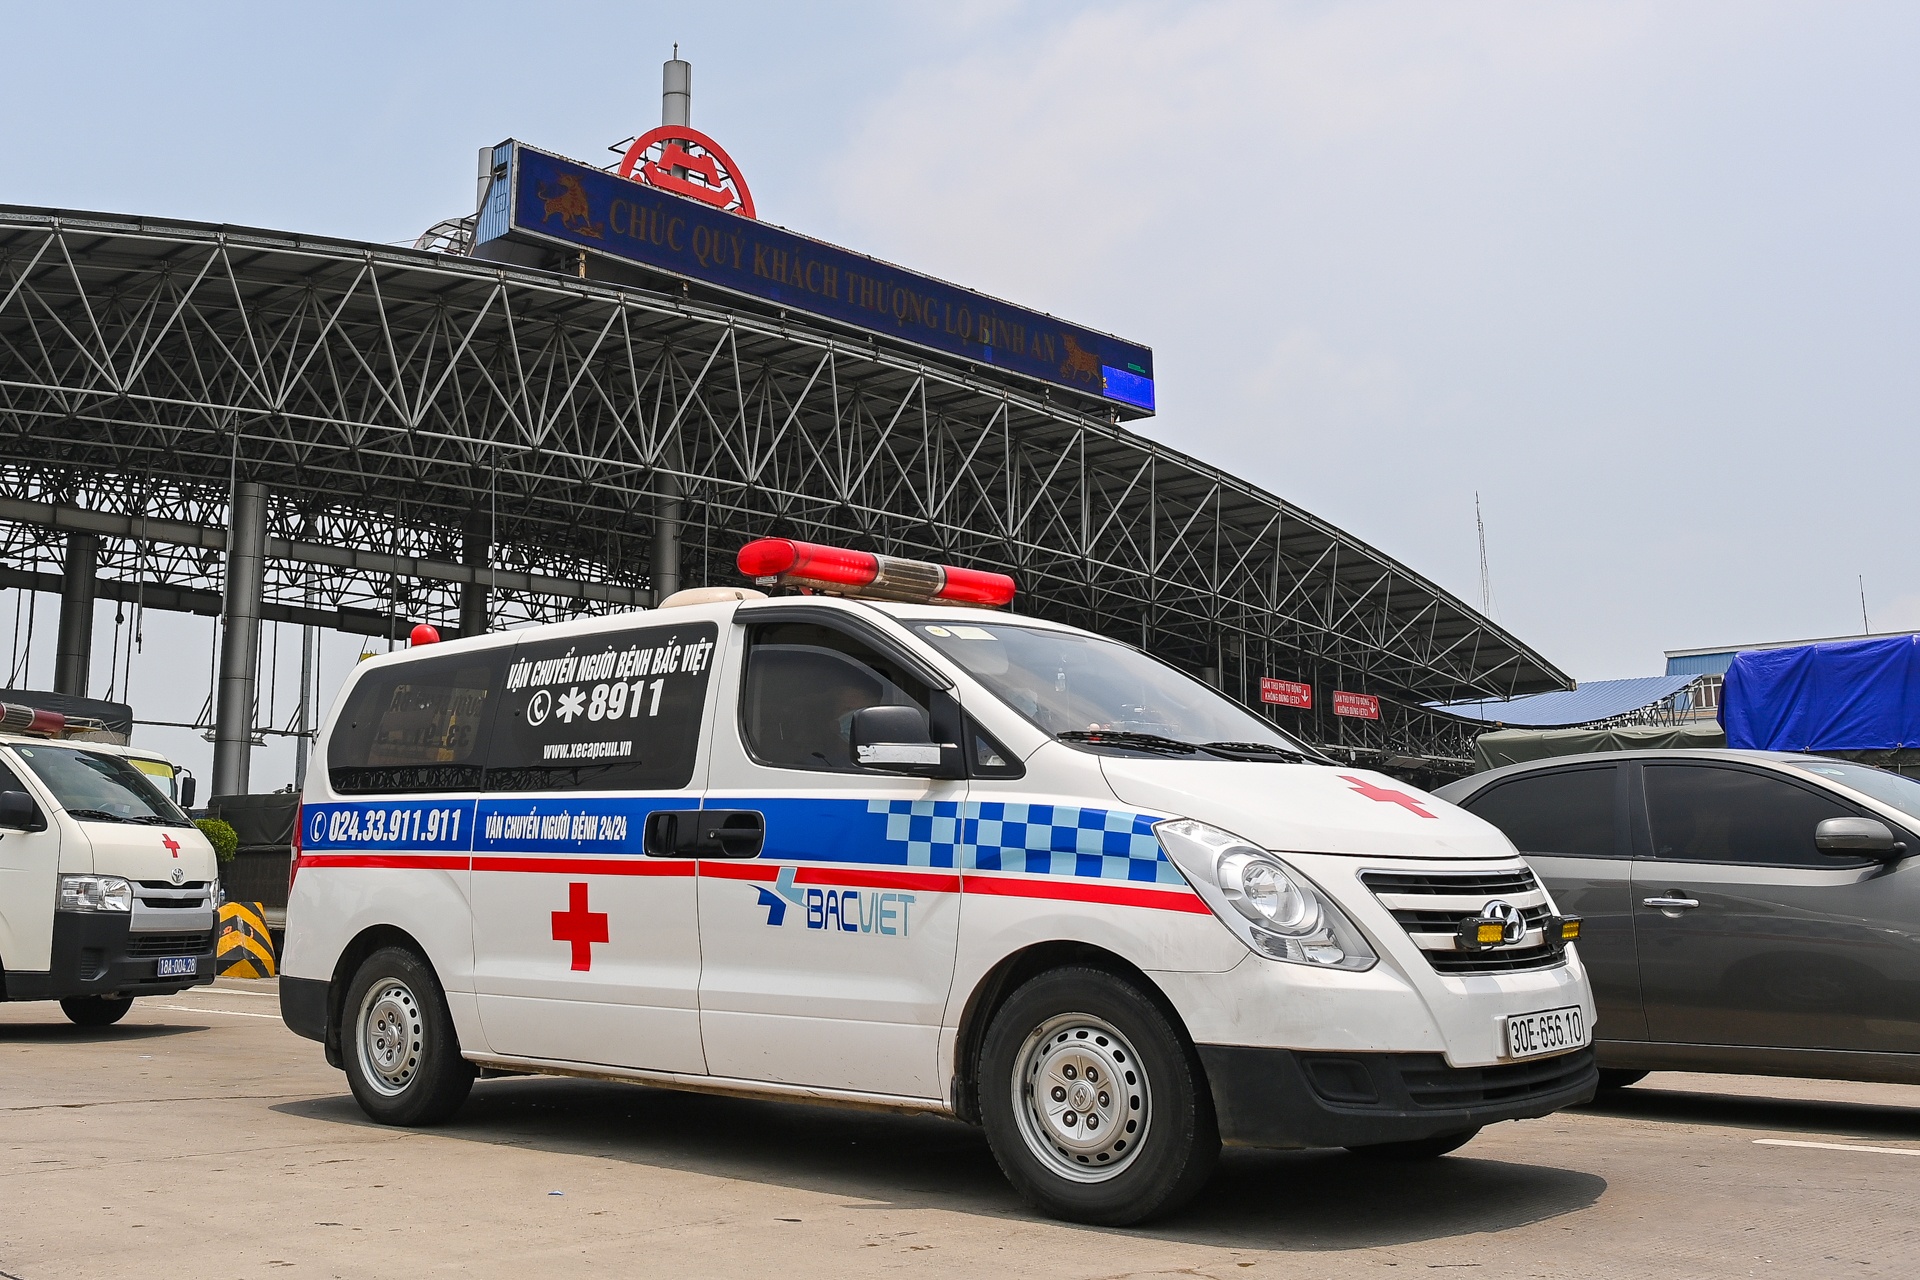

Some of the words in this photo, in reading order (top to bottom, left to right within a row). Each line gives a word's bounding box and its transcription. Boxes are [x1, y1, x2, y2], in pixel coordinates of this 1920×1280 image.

[609, 198, 685, 251] CHÚC
[692, 225, 746, 269] QUÝ
[754, 242, 839, 299] KHÁCH
[845, 270, 938, 328] THƯỢNG
[944, 303, 972, 346] LỘ
[978, 308, 1025, 355] BÌNH
[1031, 330, 1055, 364] AN
[506, 657, 533, 692] VẬN
[530, 646, 579, 686] CHUYỂN
[576, 644, 617, 682] NGƯỜI
[614, 644, 653, 682] BỆNH
[651, 635, 681, 675] BẮC
[681, 637, 713, 676] VIỆT
[543, 740, 632, 759] www.xecapcuu.vn
[328, 809, 461, 841] 024.33.911.911
[485, 810, 504, 844] VẬN
[504, 806, 541, 839] CHUYỂN
[540, 809, 571, 840] NGƯỜI
[571, 810, 599, 845] BỆNH
[599, 815, 627, 840] 24/24
[807, 888, 915, 936] BACVIET
[1511, 1011, 1582, 1053] 30E-656.10
